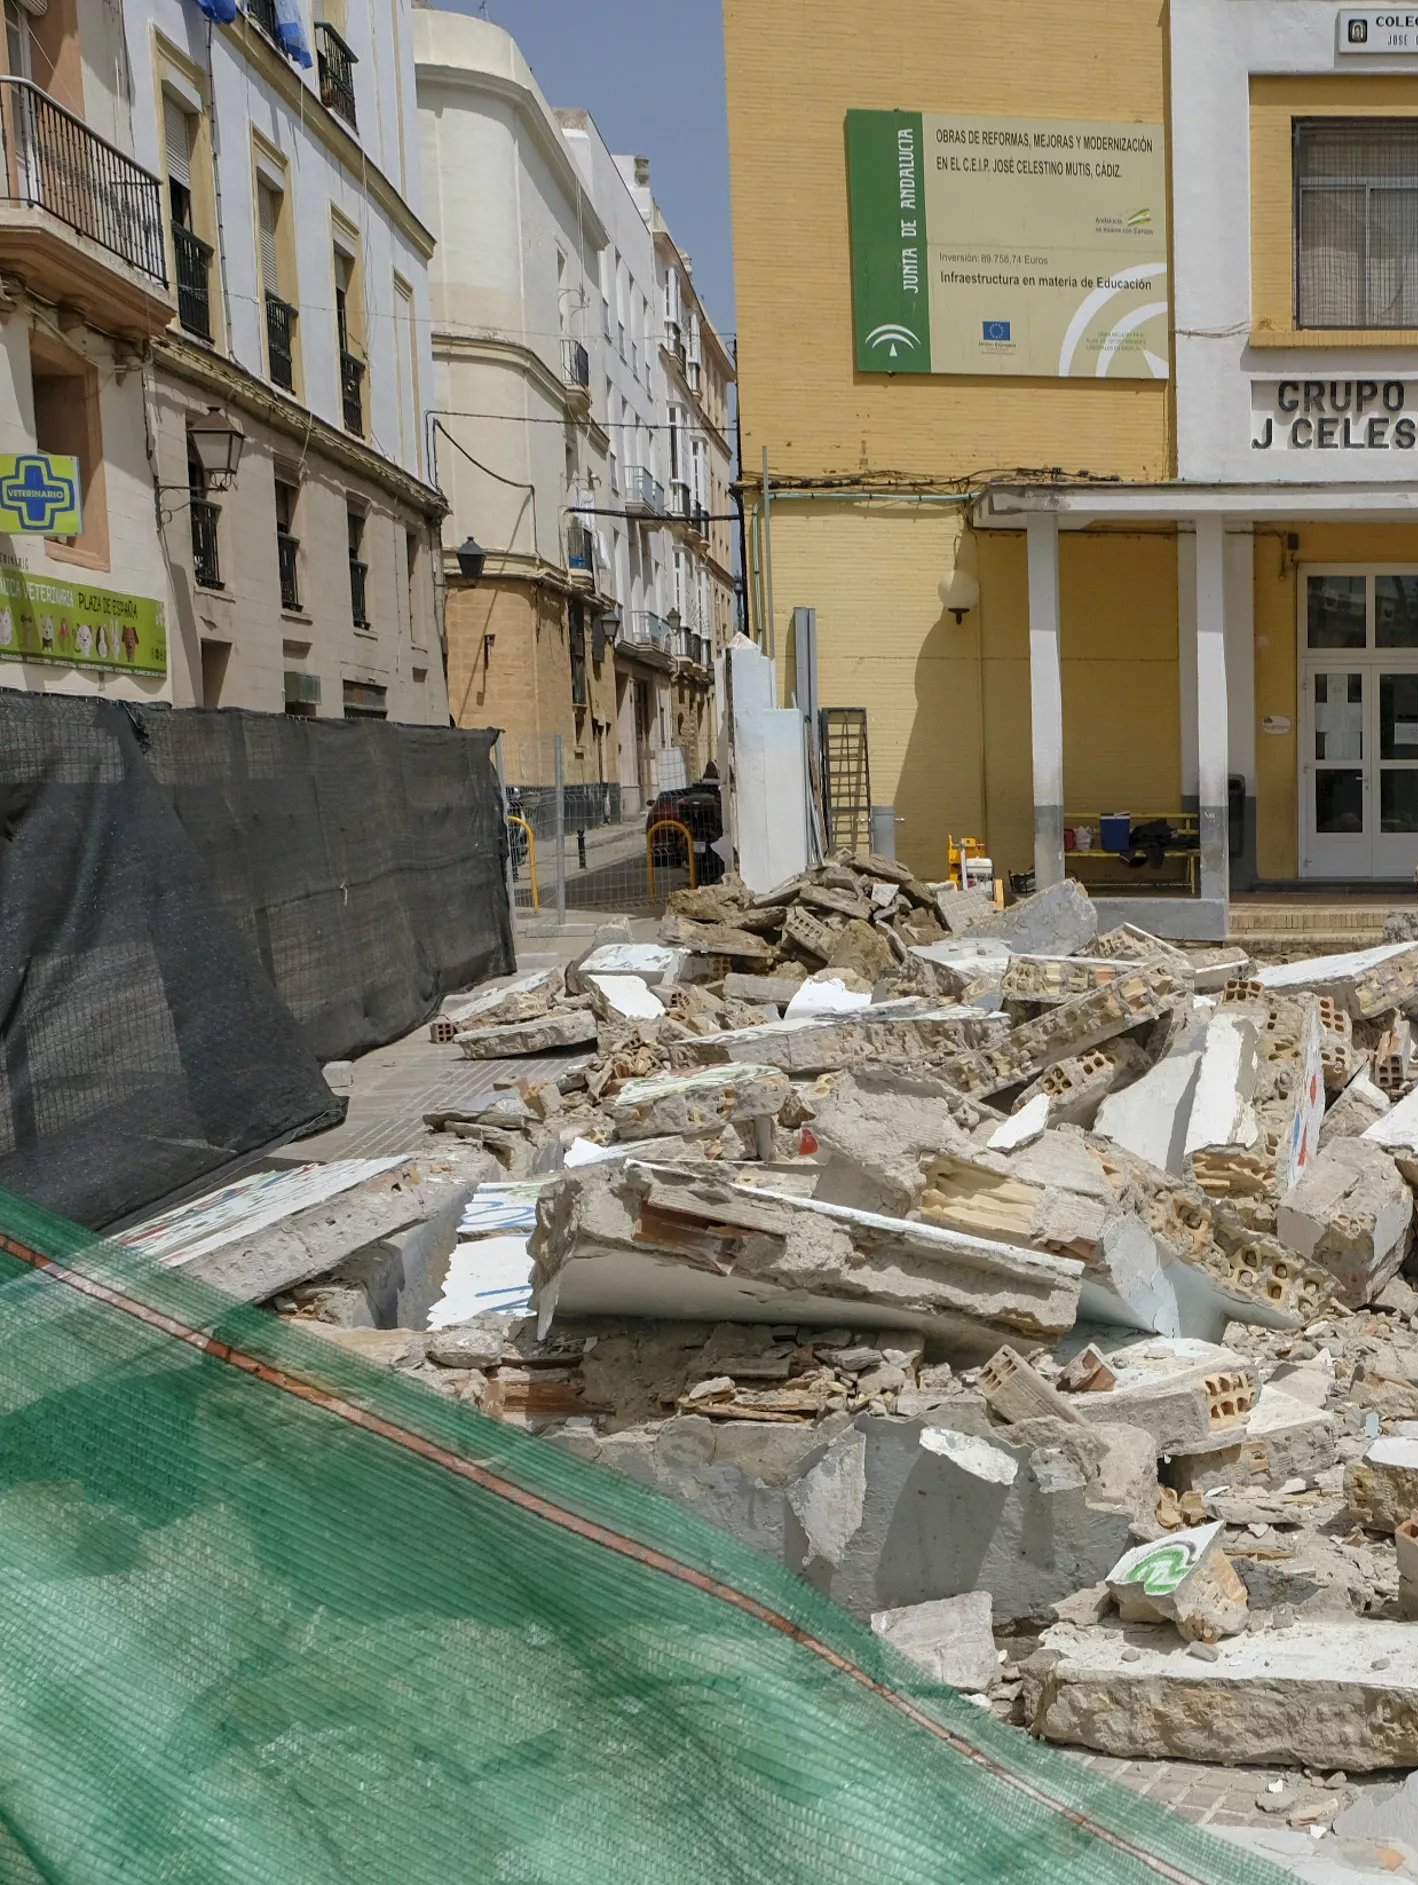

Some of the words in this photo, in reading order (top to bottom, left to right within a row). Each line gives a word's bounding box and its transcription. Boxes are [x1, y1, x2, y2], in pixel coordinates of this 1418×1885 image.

[1387, 34, 1408, 46] JOSE
[936, 128, 966, 144] OBRAS
[968, 130, 980, 145] DE
[982, 131, 1032, 150] REFORMAS,
[1033, 133, 1074, 149] MEJORAS
[1076, 135, 1082, 149] Y
[1083, 135, 1153, 153] MODERNIZACIÓN
[936, 156, 948, 170] EN
[950, 156, 961, 171] EL
[992, 156, 1015, 174] JOSÉ
[1017, 159, 1064, 176] CELESTINO
[1065, 161, 1093, 179] MUTIS,
[901, 219, 917, 237] DE
[902, 247, 919, 294] JUNTA
[1024, 255, 1048, 265] Euros
[940, 271, 1020, 285] Infraestructura
[1022, 276, 1036, 286] en
[1038, 275, 1078, 288] materia
[1080, 276, 1094, 288] de
[1096, 276, 1152, 290] Educación
[1278, 380, 1405, 412] GRUPO
[1251, 418, 1273, 449] J
[7, 488, 64, 499] VETERINARIO
[24, 581, 74, 607] VETERINARIA
[78, 591, 101, 612] PLAZA
